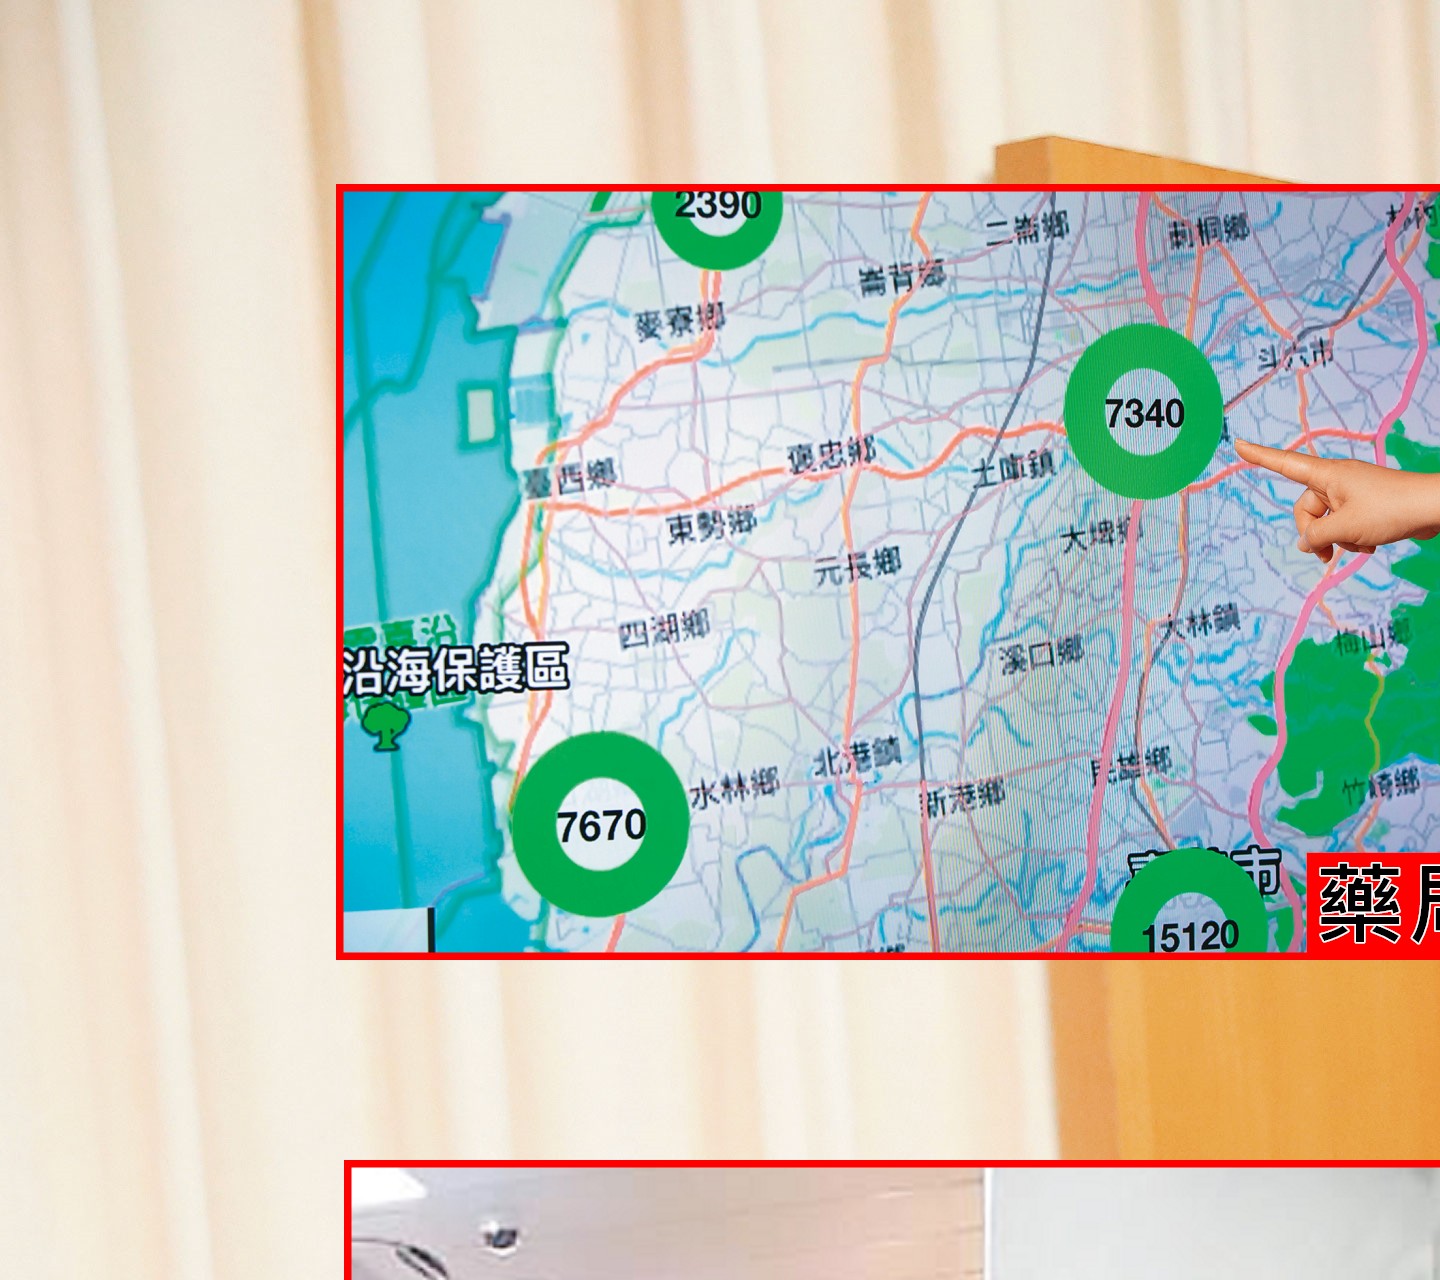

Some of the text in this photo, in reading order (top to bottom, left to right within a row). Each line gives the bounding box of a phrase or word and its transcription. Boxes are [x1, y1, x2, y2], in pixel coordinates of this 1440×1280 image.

[675, 191, 762, 219] 2390
[1258, 337, 1333, 371] 斗六市
[1105, 398, 1185, 429] 7340
[665, 504, 758, 546] 東勢鄉
[814, 546, 901, 588] 元長鄉
[619, 607, 711, 650] 四湖鄉
[344, 642, 570, 695] 沿海保護區
[690, 766, 780, 808] 水林鄉
[556, 809, 647, 842] 7670
[1142, 920, 1239, 953] 15120
